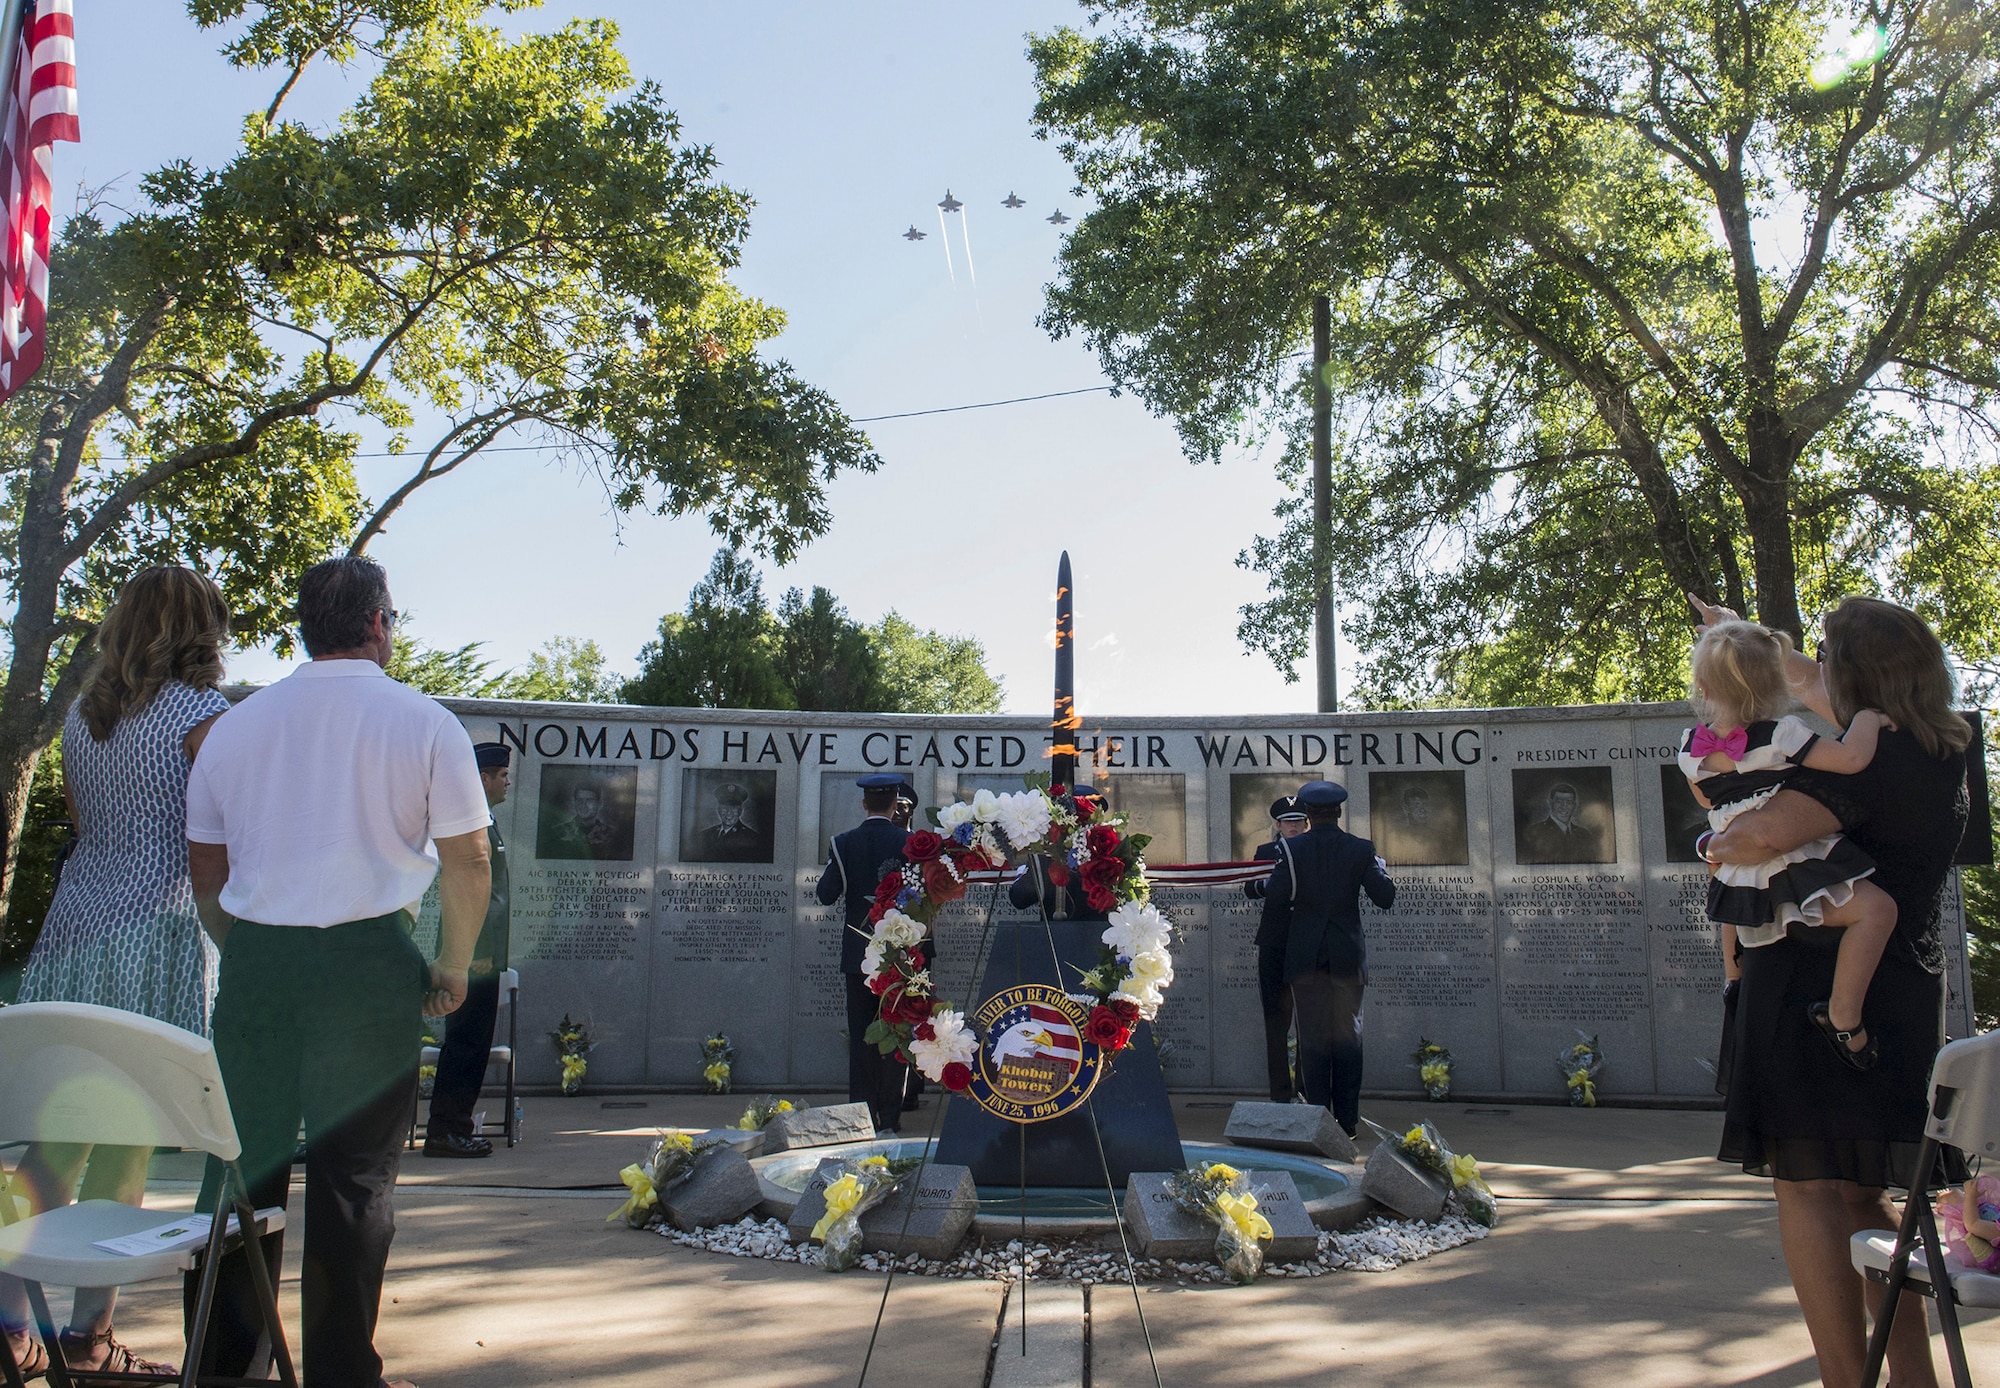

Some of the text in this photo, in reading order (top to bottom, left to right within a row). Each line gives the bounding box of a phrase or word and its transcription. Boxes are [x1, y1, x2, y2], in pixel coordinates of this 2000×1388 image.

[497, 722, 700, 762] NOMADS
[722, 730, 838, 765] HAVE
[861, 732, 1026, 768] CEASED
[1516, 747, 1597, 763] PRESIDENT
[748, 874, 783, 882] FENNIG
[1657, 924, 1711, 932] NOVEMBER
[978, 999, 1007, 1026] EVER
[1006, 990, 1023, 1004] TO
[1027, 988, 1042, 1000] BE
[1001, 1064, 1056, 1080] Khobar
[1001, 1078, 1052, 1093] Towers
[984, 1093, 1059, 1118] JUNE 25, 1996
[916, 1188, 952, 1199] ADAMS
[1262, 1207, 1276, 1215] FL
